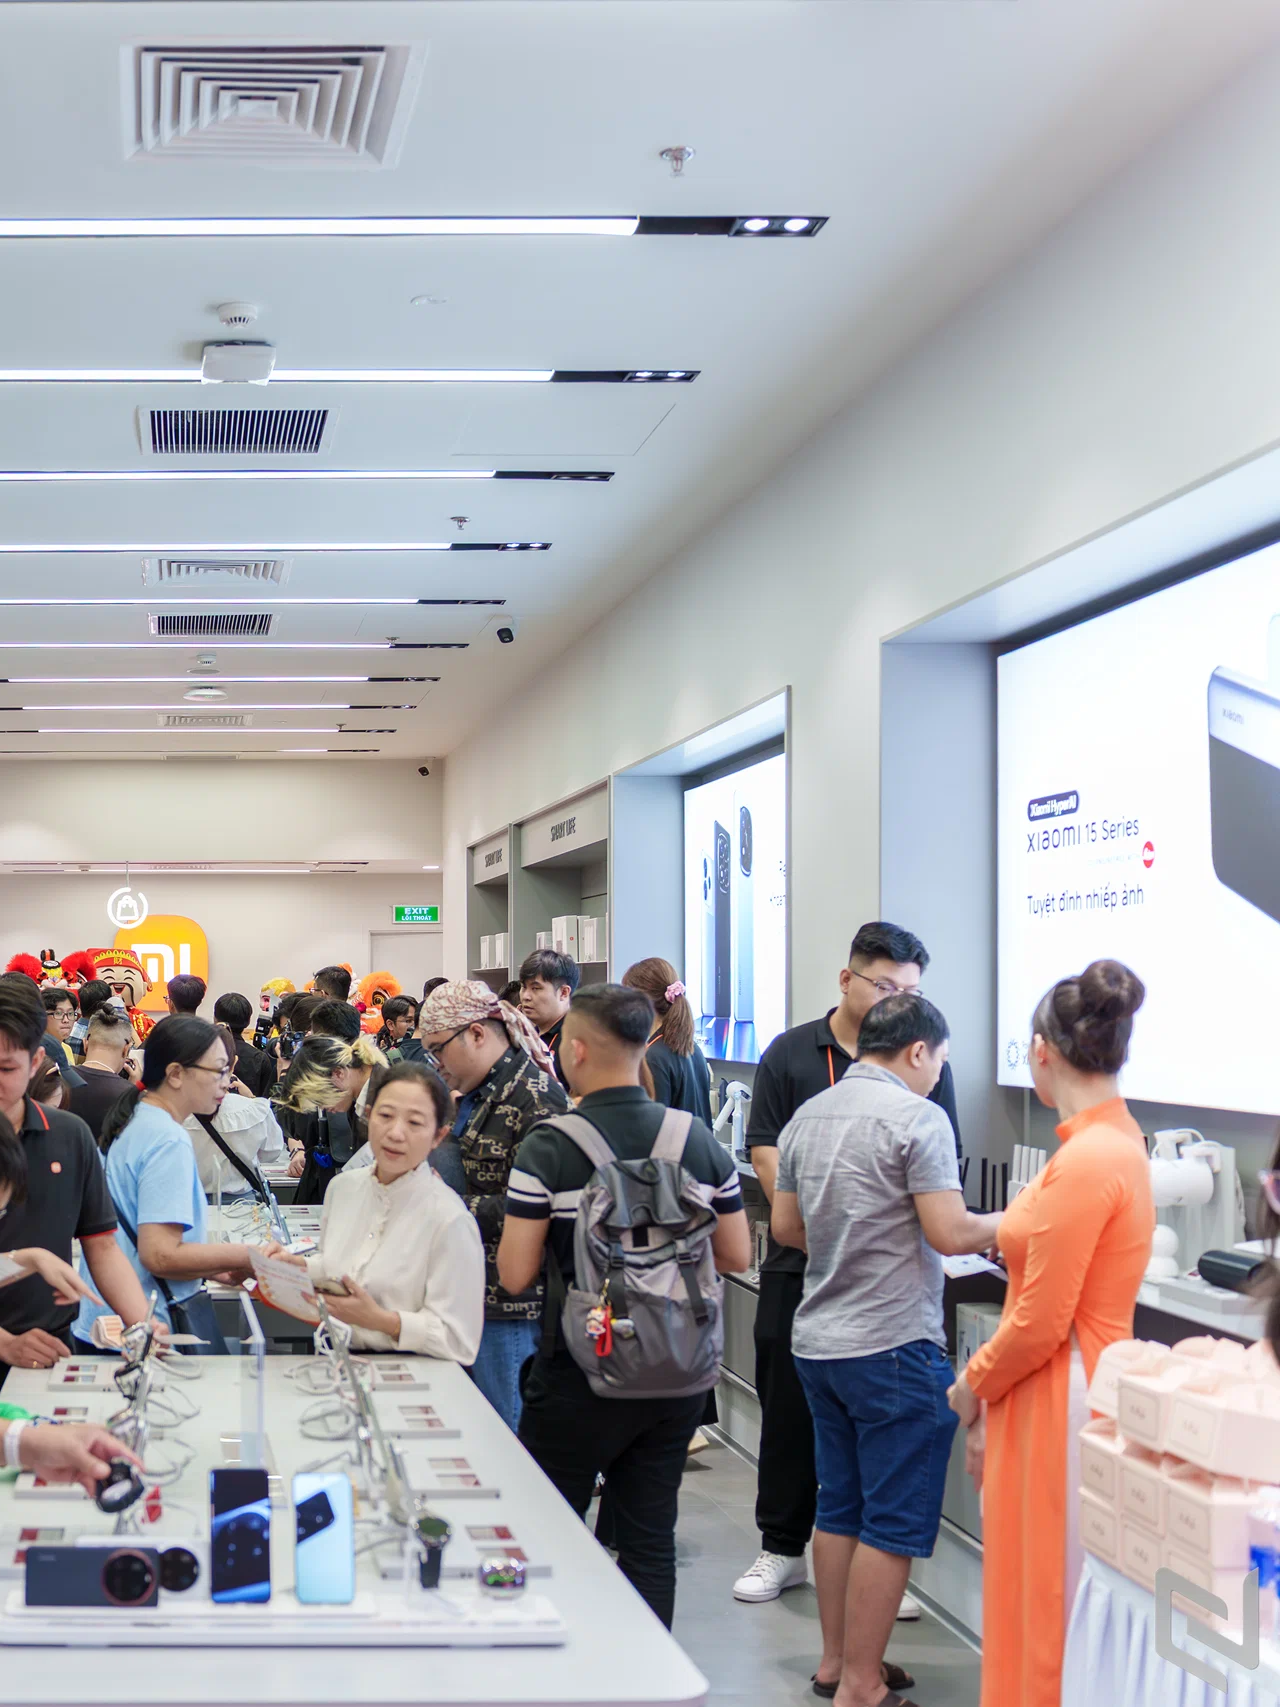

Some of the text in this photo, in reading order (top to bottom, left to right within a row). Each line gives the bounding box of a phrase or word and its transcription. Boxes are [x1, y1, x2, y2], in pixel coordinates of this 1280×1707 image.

[1085, 822, 1097, 842] 15
[1102, 816, 1139, 840] Series
[404, 907, 429, 915] EXIT
